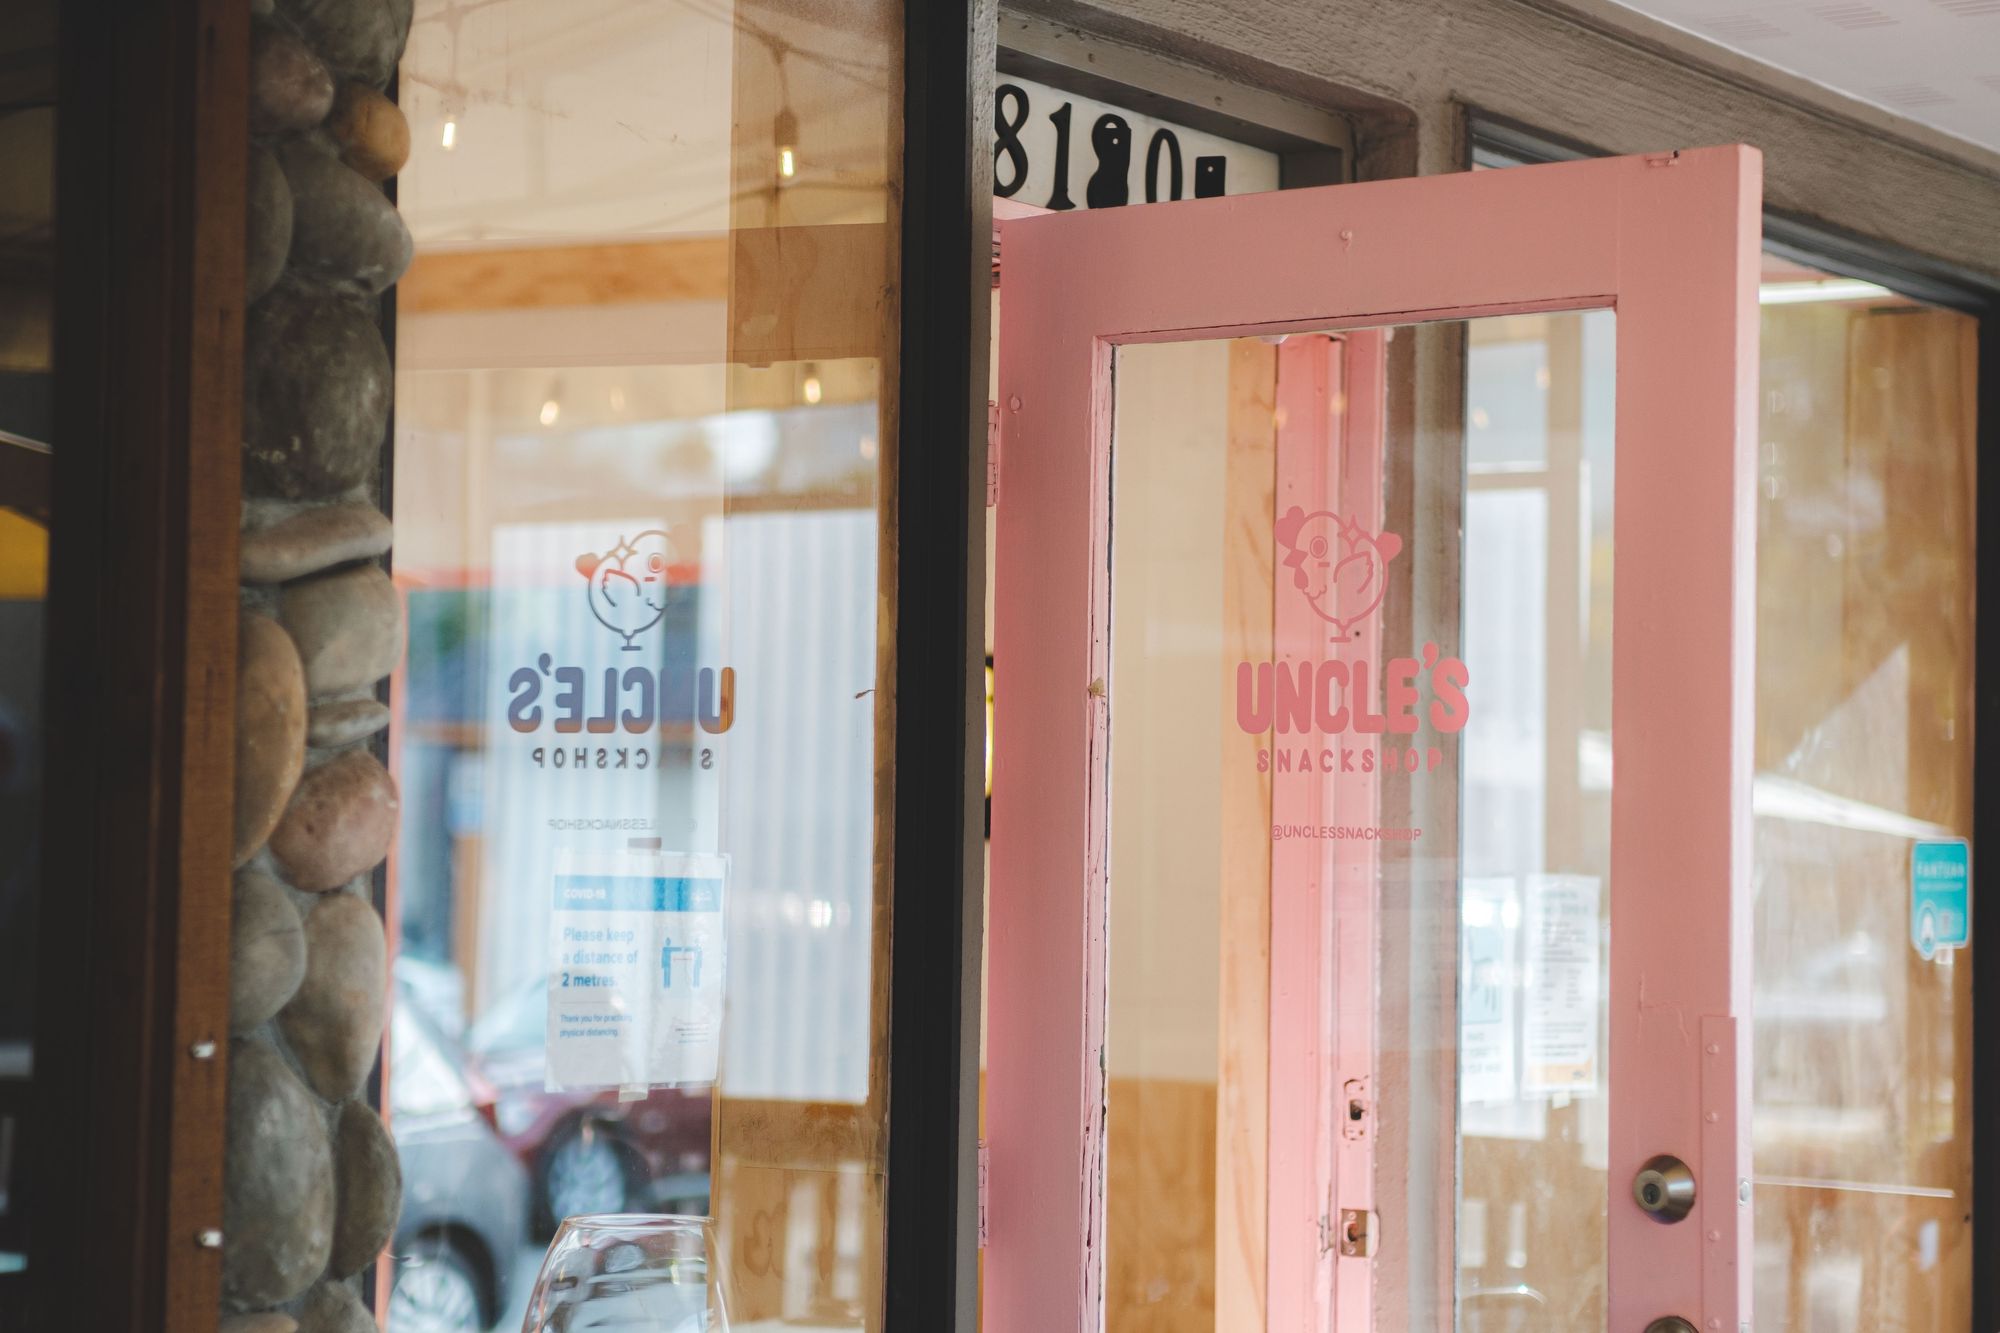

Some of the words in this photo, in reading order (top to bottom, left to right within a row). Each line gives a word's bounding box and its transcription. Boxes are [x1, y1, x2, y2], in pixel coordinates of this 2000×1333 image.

[1236, 642, 1470, 735] UNCLE'S
[1256, 748, 1442, 773] SNACKSHOP
[1271, 825, 1422, 842] @UNCLESSNACKSHOP
[563, 927, 604, 942] Please
[606, 928, 634, 944] keep
[562, 953, 570, 964] a
[573, 950, 623, 964] distance
[627, 950, 639, 964] of
[561, 973, 570, 987] 2
[580, 1015, 593, 1024] you
[594, 1014, 603, 1022] for
